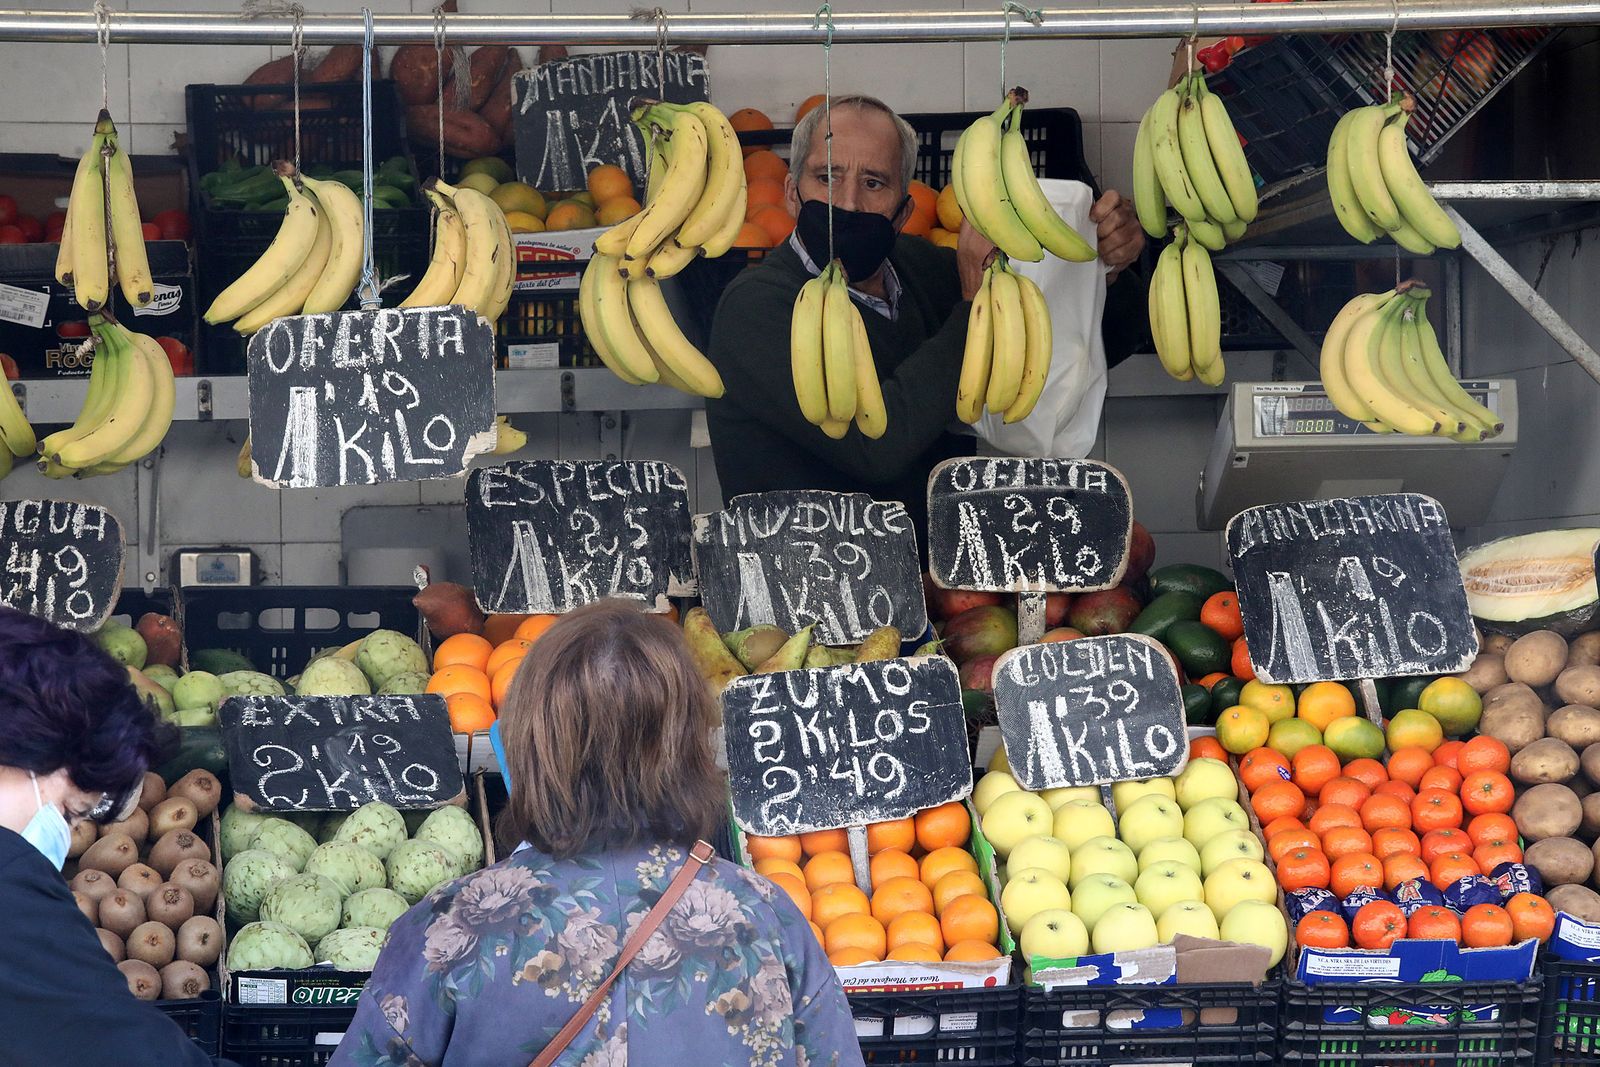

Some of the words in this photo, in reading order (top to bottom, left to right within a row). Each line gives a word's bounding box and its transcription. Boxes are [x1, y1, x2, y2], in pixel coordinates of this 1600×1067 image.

[265, 305, 465, 375] OFERTA
[479, 461, 688, 508] ESPECIAL
[951, 459, 1108, 493] OFERTA
[1235, 496, 1444, 558] MANDARINA
[1007, 638, 1155, 688] GOLDEN
[241, 696, 422, 727] EXTRA
[735, 662, 912, 715] ZUMO
[748, 719, 786, 764] 2
